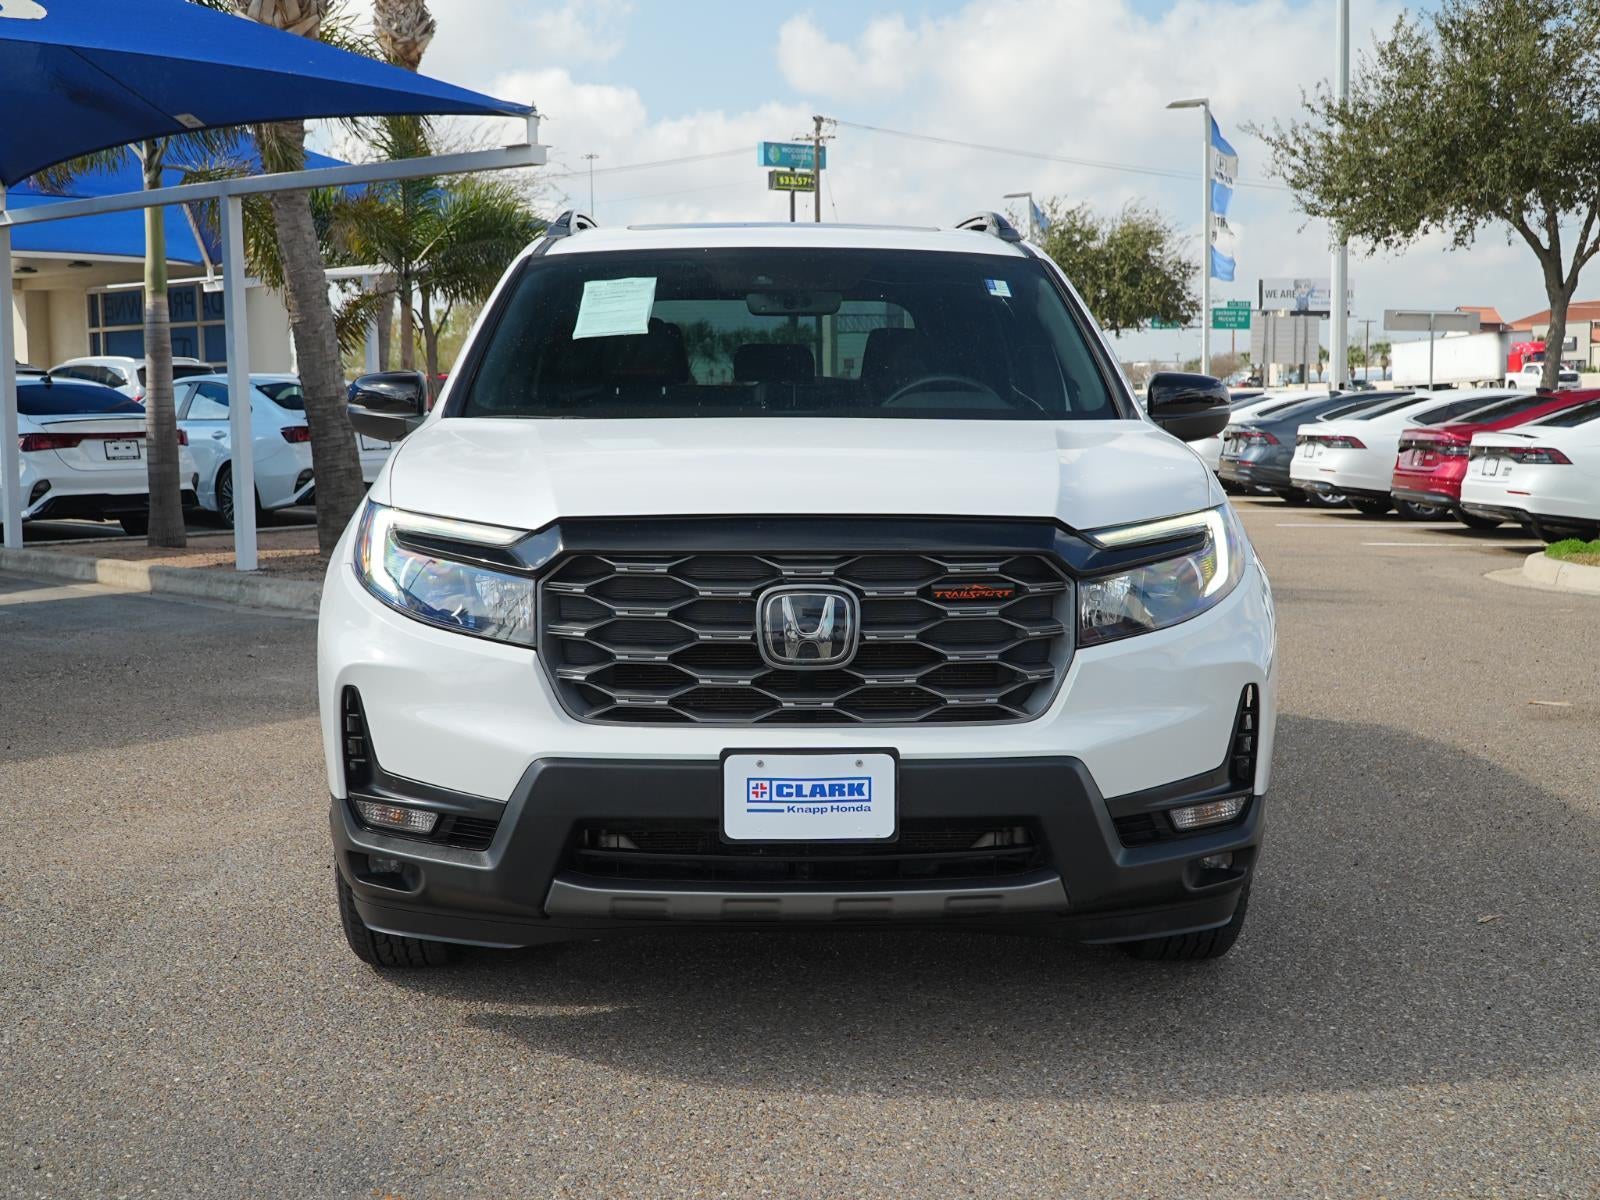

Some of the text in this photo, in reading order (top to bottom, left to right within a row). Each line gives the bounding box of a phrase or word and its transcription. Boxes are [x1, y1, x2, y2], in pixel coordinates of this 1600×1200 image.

[1265, 290, 1277, 298] WE
[775, 782, 866, 798] CLARK
[787, 804, 872, 815] Knapp Honda
